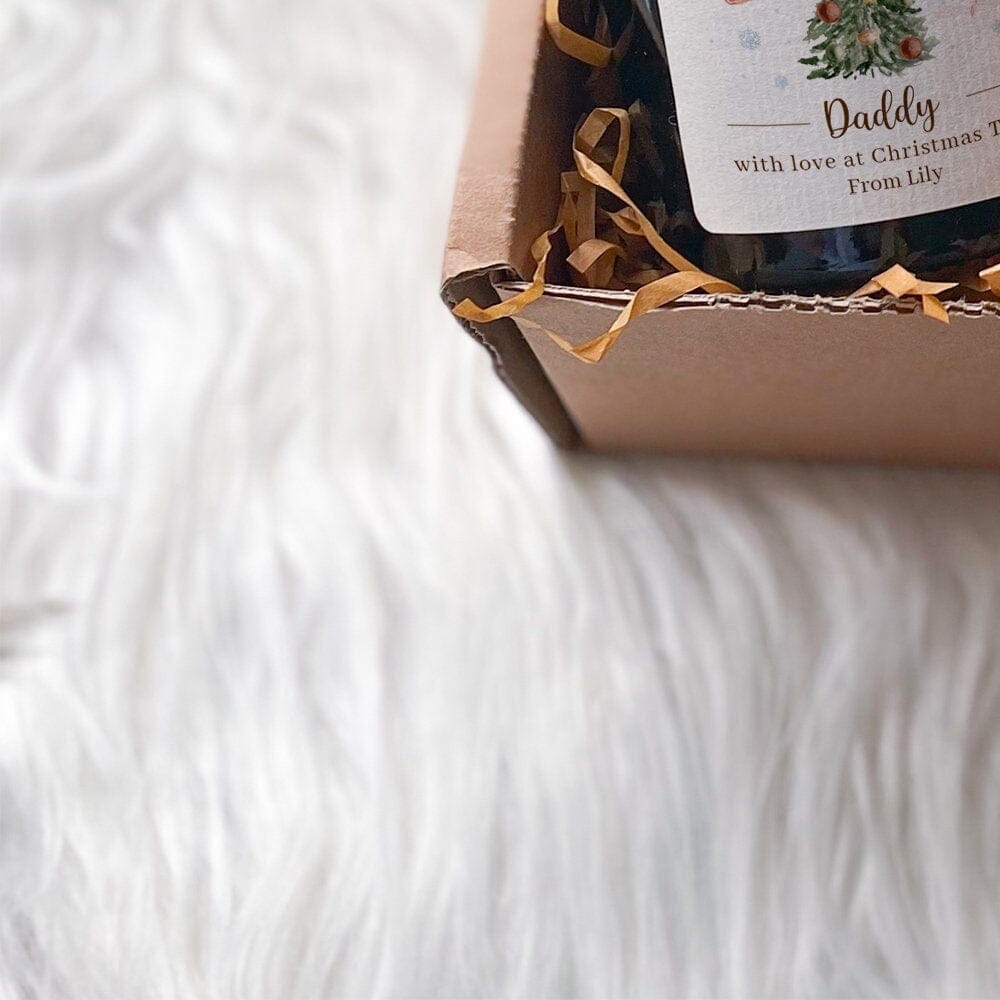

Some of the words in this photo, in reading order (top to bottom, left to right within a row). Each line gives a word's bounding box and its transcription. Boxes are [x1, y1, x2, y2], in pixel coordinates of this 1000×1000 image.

[823, 84, 940, 139] Daddy
[733, 154, 785, 173] with
[790, 153, 837, 172] love
[843, 151, 865, 168] at
[871, 128, 983, 164] Christmas
[847, 176, 902, 196] From
[906, 165, 943, 186] Lily
